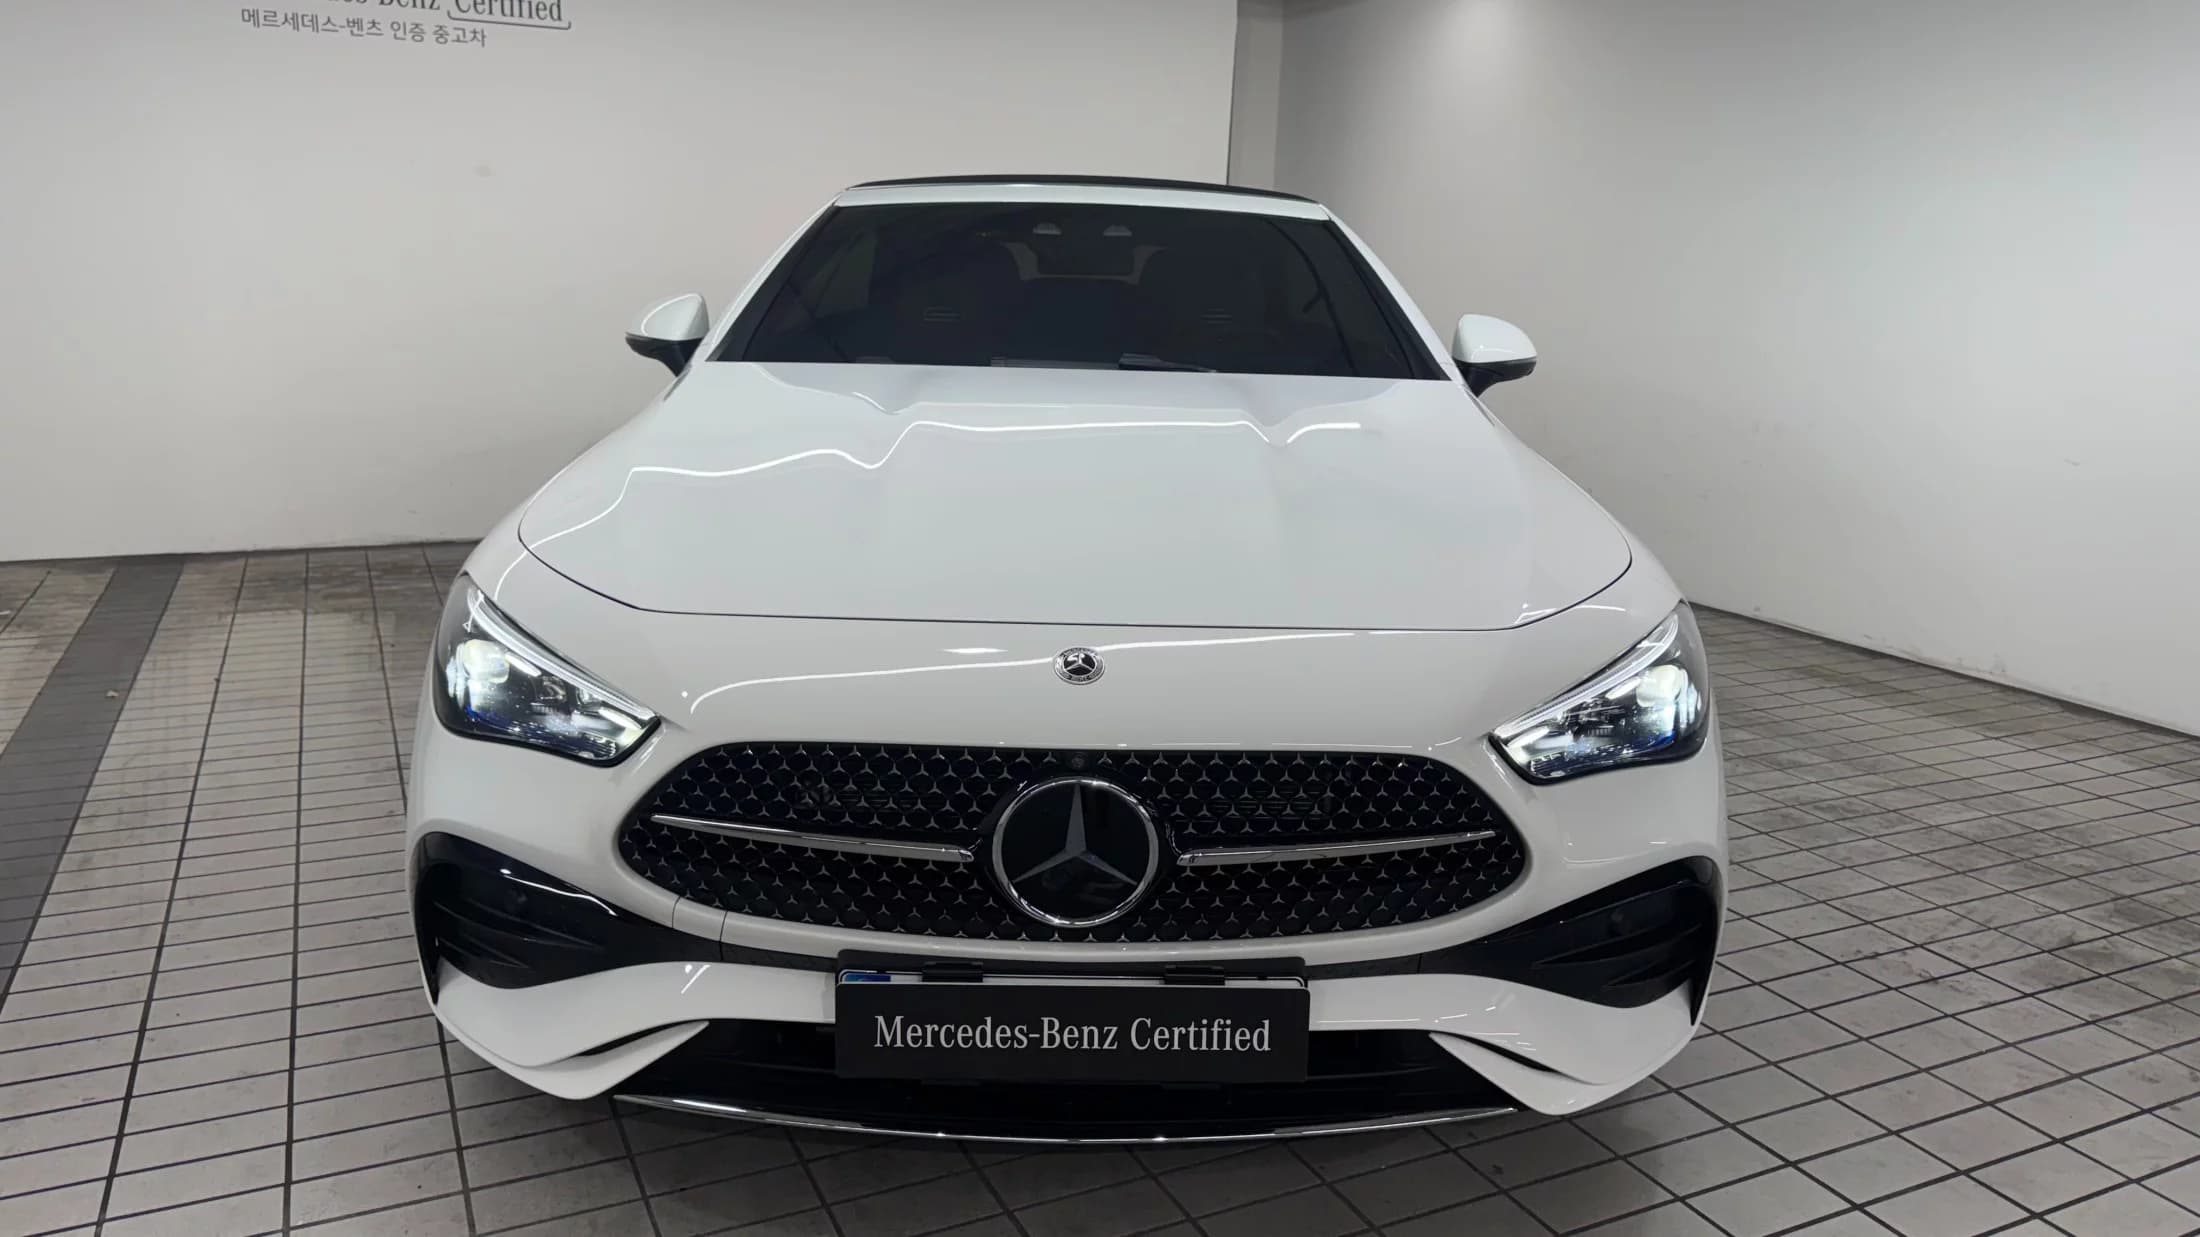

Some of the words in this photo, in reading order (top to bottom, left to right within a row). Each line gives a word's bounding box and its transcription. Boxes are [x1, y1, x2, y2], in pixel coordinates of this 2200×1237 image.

[241, 8, 384, 37] 메르세데스-벤츠
[390, 21, 426, 43] 인증
[432, 24, 487, 48] 중고차
[873, 1015, 1119, 1050] Mercedes-Benz
[1130, 1017, 1272, 1052] Certified
